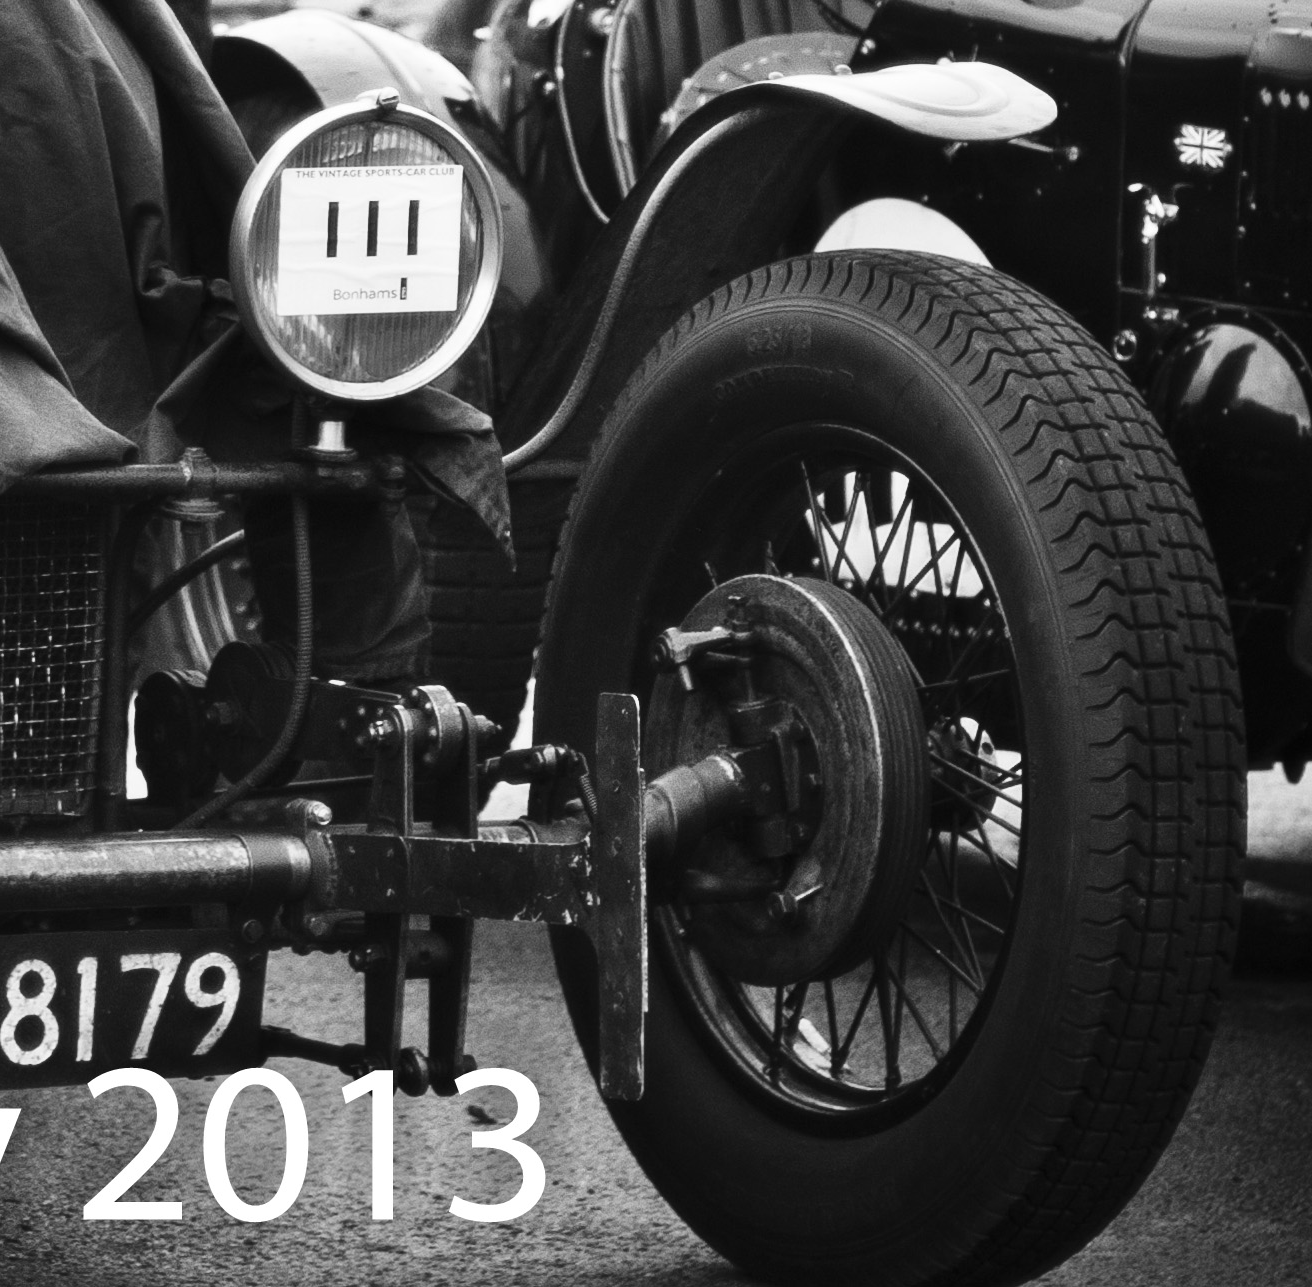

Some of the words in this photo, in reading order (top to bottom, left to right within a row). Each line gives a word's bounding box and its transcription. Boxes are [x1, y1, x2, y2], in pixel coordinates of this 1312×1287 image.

[296, 170, 315, 179] THE
[319, 169, 362, 178] VINTAGE
[365, 168, 426, 177] SPORTS-CAR
[429, 166, 455, 176] CLUB
[326, 200, 420, 258] 111
[332, 287, 398, 301] Bonhams
